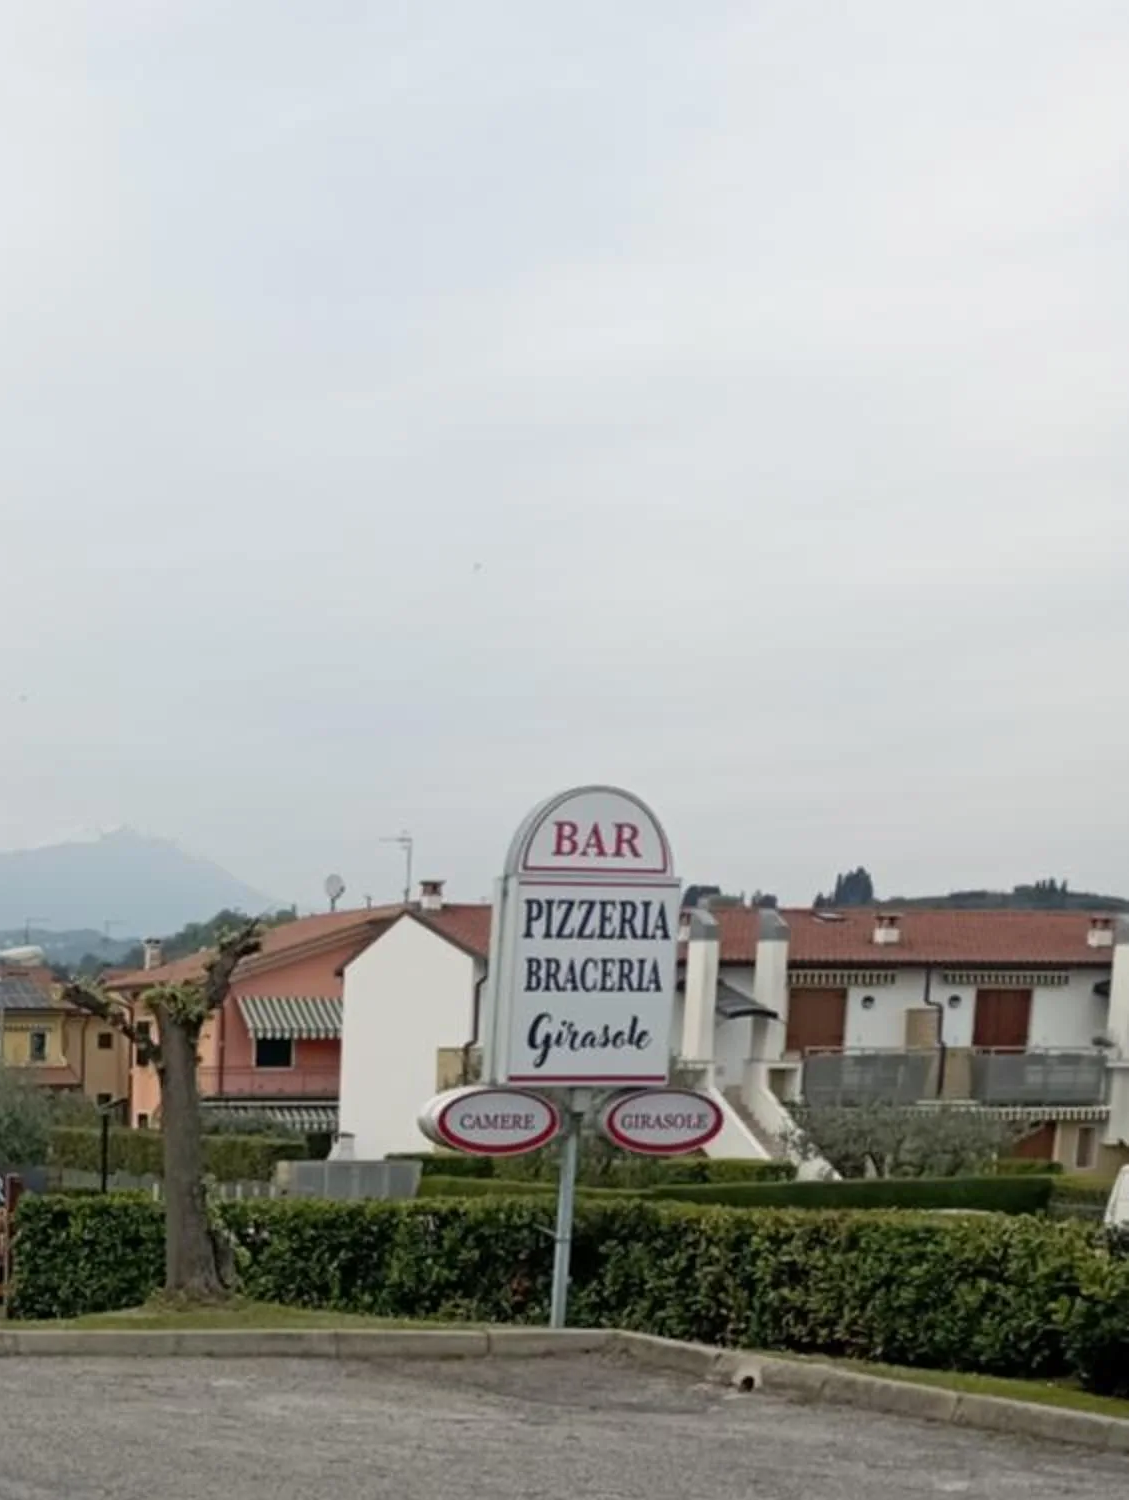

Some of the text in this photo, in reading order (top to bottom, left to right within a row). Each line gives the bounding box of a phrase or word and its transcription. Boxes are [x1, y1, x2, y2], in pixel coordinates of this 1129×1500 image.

[552, 821, 642, 859] BAR
[522, 899, 670, 940] PIZZERIA
[523, 957, 663, 993] BRACERIA
[527, 1013, 651, 1068] Girasole
[459, 1112, 535, 1130] CAMERE
[620, 1113, 708, 1130] GIRASOLE
